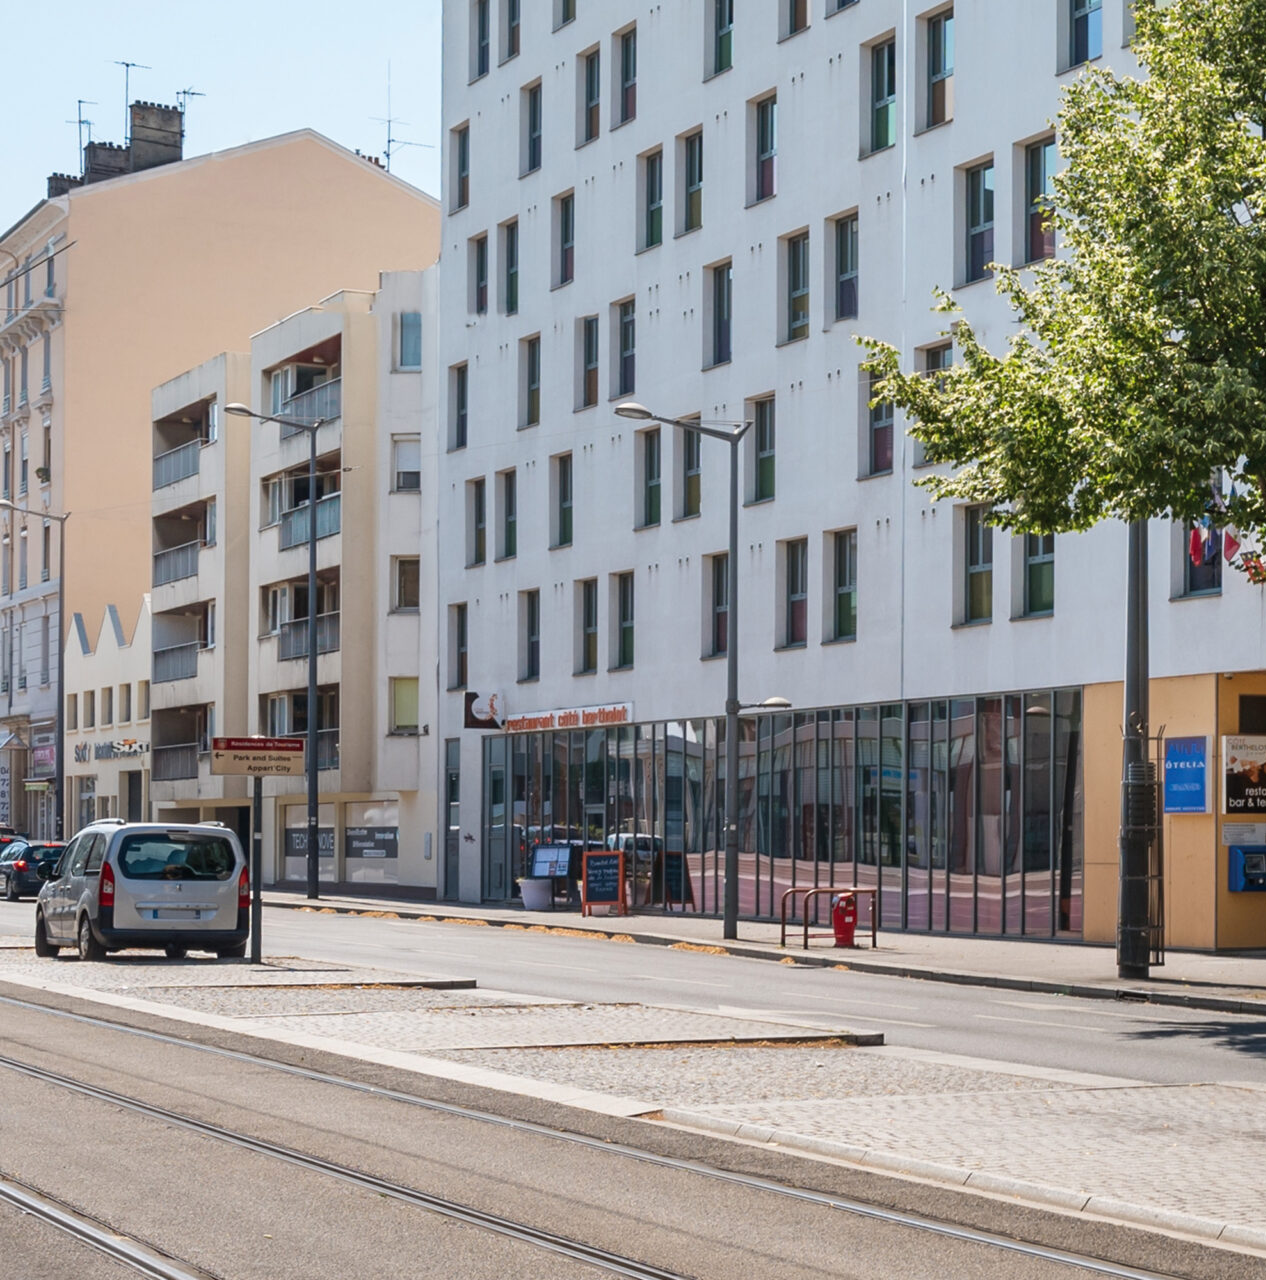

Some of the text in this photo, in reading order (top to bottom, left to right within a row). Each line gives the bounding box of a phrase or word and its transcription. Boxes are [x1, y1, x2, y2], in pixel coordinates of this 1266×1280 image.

[507, 713, 554, 731] restaurant
[582, 705, 627, 725] berthelot
[1228, 797, 1245, 807] bar
[1247, 797, 1255, 807] &
